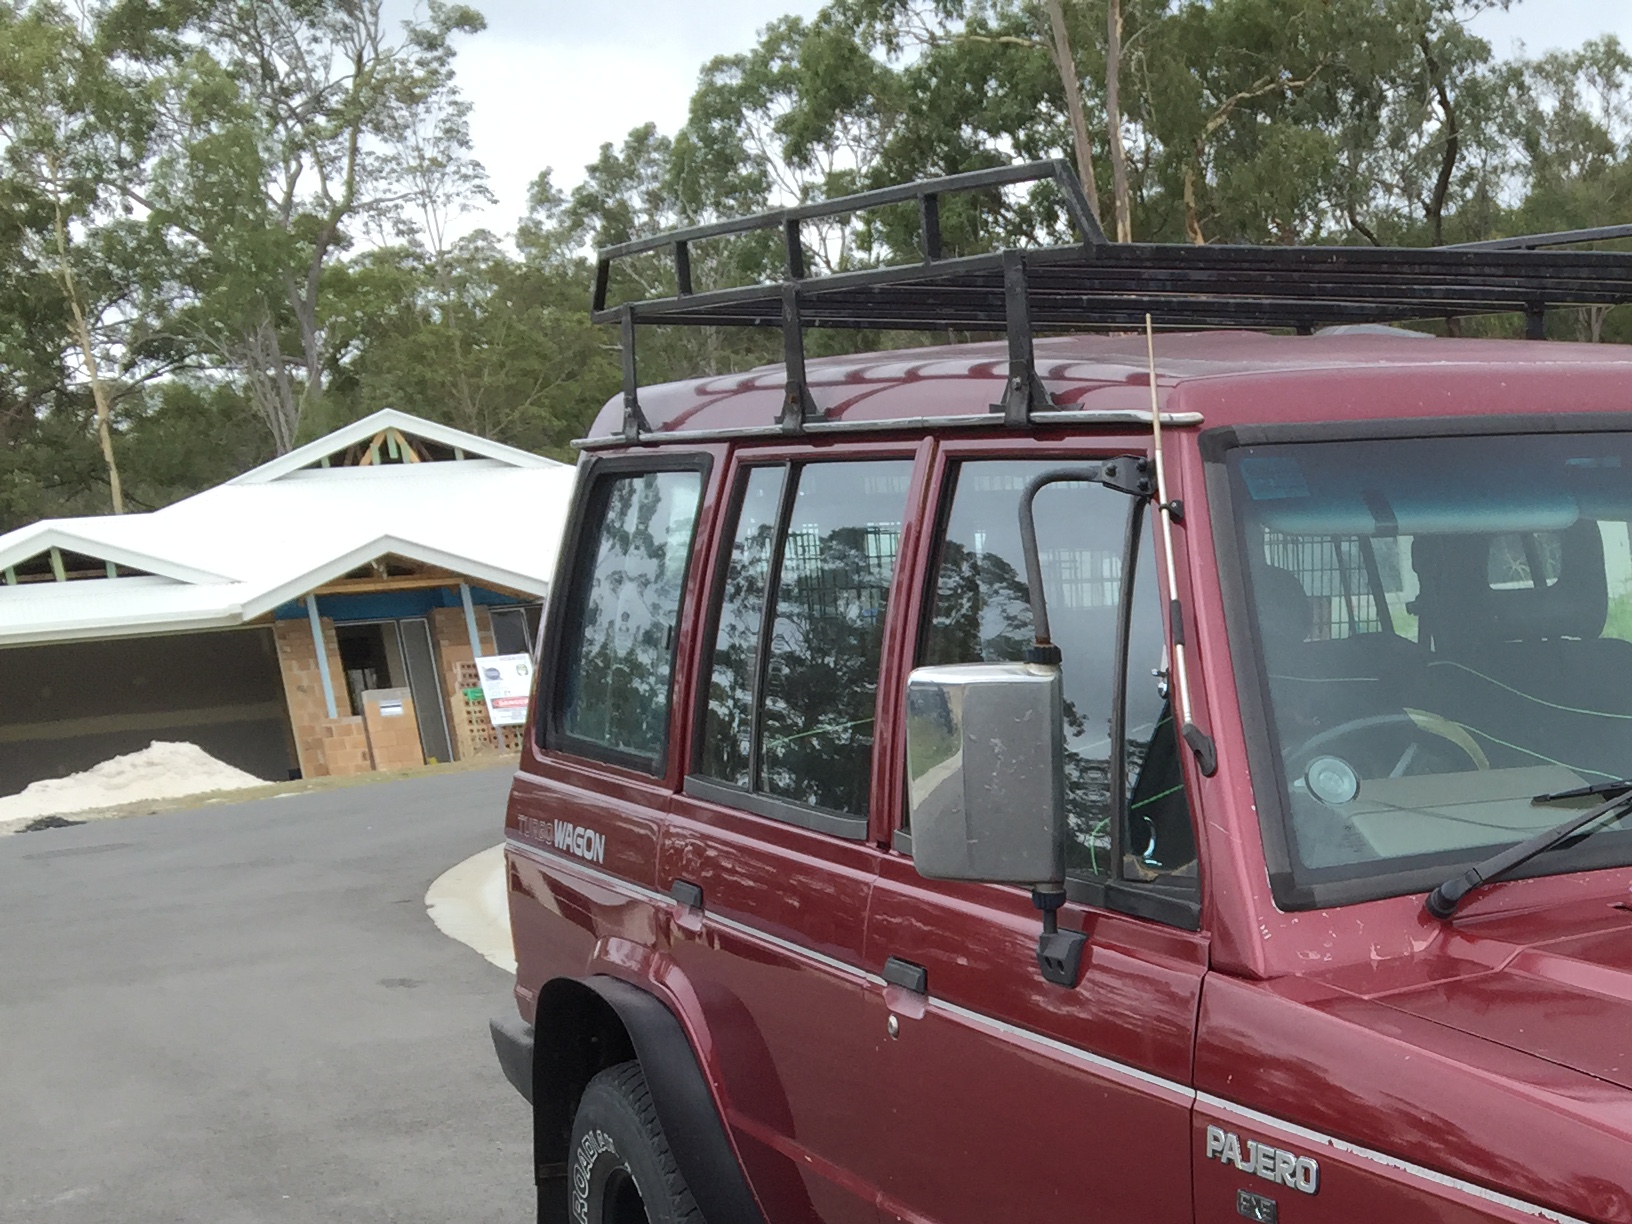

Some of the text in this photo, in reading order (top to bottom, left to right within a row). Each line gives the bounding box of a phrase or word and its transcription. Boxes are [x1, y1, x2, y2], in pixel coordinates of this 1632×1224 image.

[517, 814, 606, 865] TURBO WAGON
[1206, 1124, 1319, 1195] PAJERO
